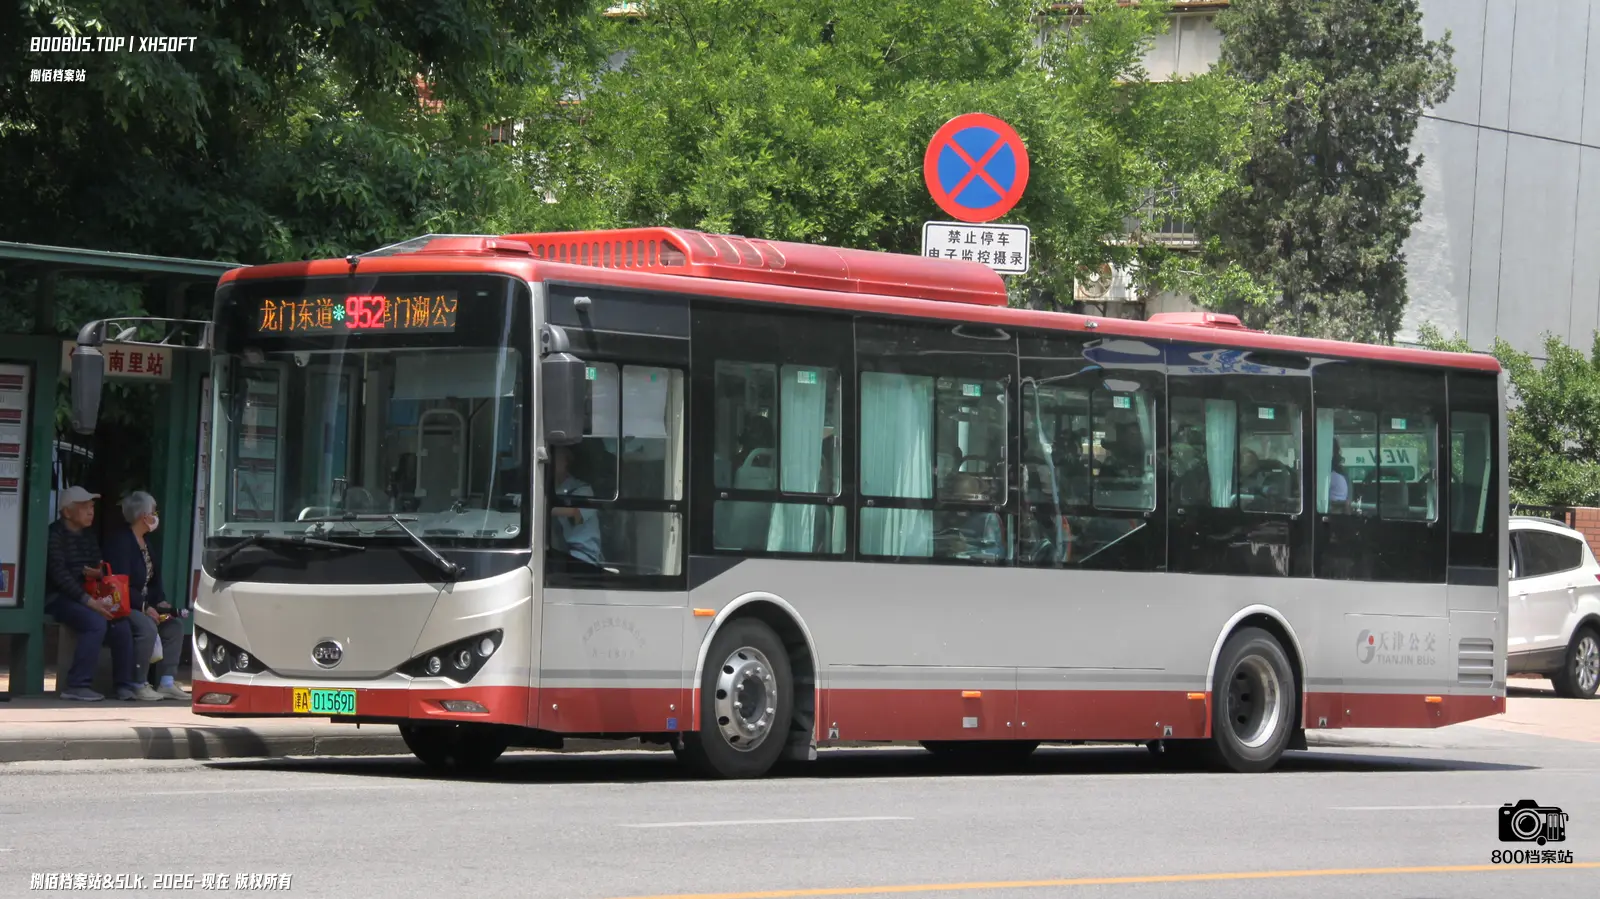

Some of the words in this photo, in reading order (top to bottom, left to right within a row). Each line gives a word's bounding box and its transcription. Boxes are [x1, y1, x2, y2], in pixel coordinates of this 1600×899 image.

[948, 230, 1010, 246] 禁止停车
[929, 248, 1023, 265] 电子监控摄录
[259, 298, 334, 331] 龙门东道
[345, 295, 385, 329] 952
[1376, 631, 1436, 652] 天津公交
[1376, 654, 1414, 665] TIANJIN
[1417, 655, 1436, 666] BUS
